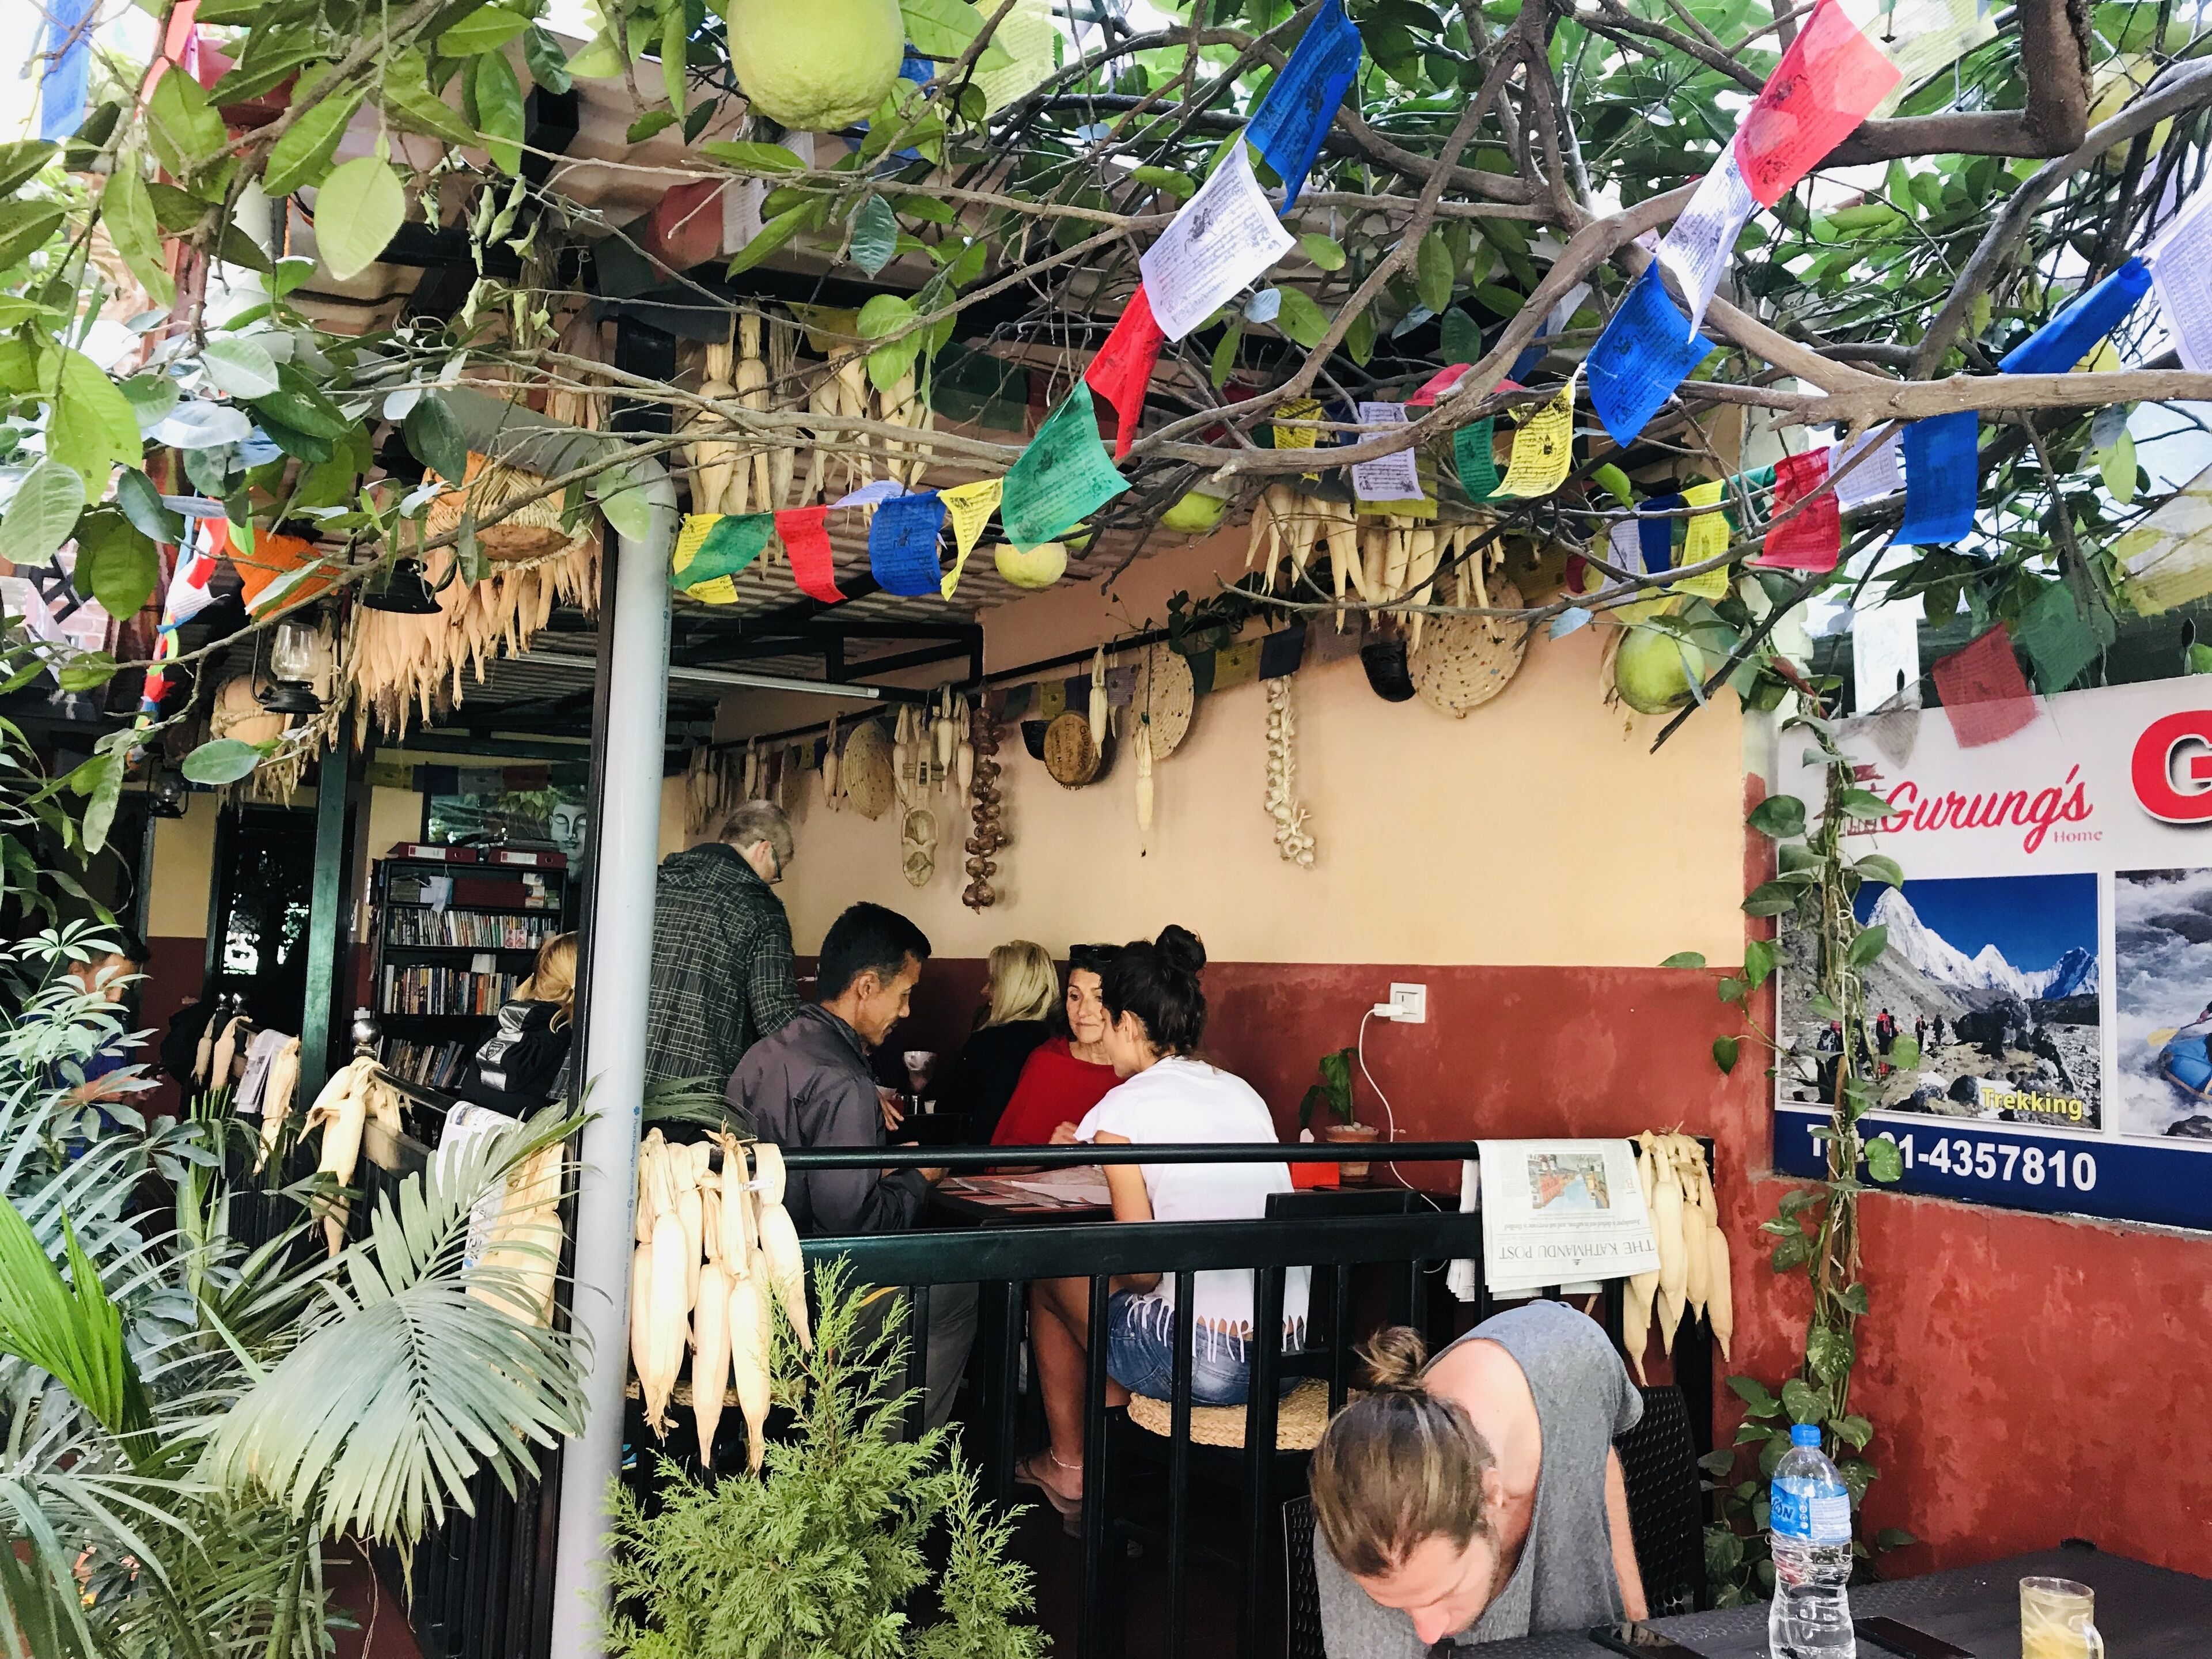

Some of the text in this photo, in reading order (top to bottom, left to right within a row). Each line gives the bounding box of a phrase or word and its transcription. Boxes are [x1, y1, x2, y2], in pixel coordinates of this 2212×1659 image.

[1881, 764, 2093, 854] Gurung's
[2054, 831, 2103, 843] Home
[1981, 1087, 2083, 1121] Trekking
[1877, 1131, 2096, 1191] 1-4357810
[1499, 1239, 1655, 1260] THE KATHMANDU POST
